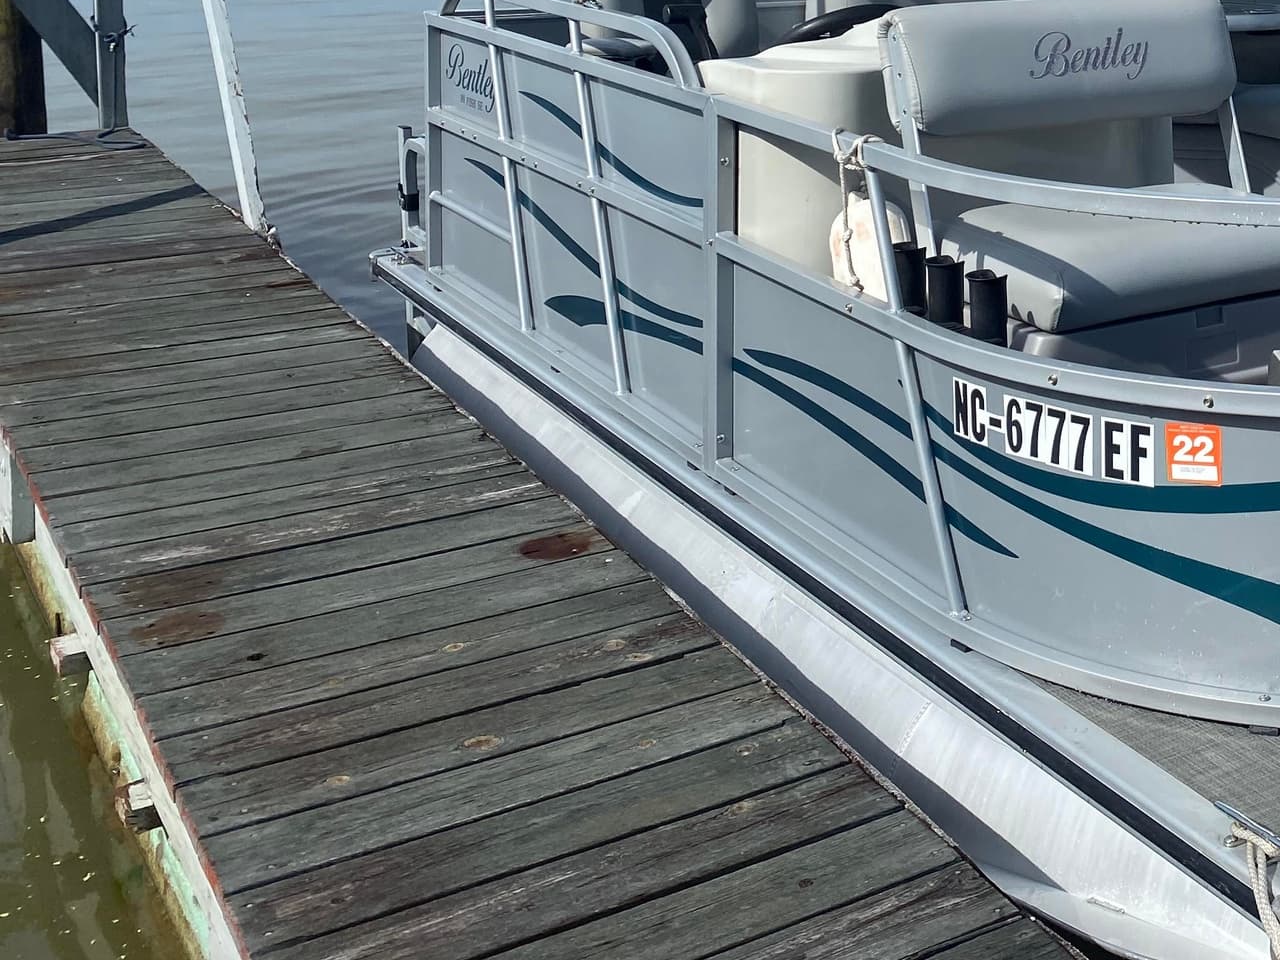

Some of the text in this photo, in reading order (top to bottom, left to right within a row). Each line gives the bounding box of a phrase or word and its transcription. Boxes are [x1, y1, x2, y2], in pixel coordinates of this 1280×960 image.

[446, 43, 497, 113] Bentley
[1029, 27, 1149, 80] Bentley
[954, 379, 1151, 483] NC-6777 EF
[1172, 434, 1215, 463] 22
